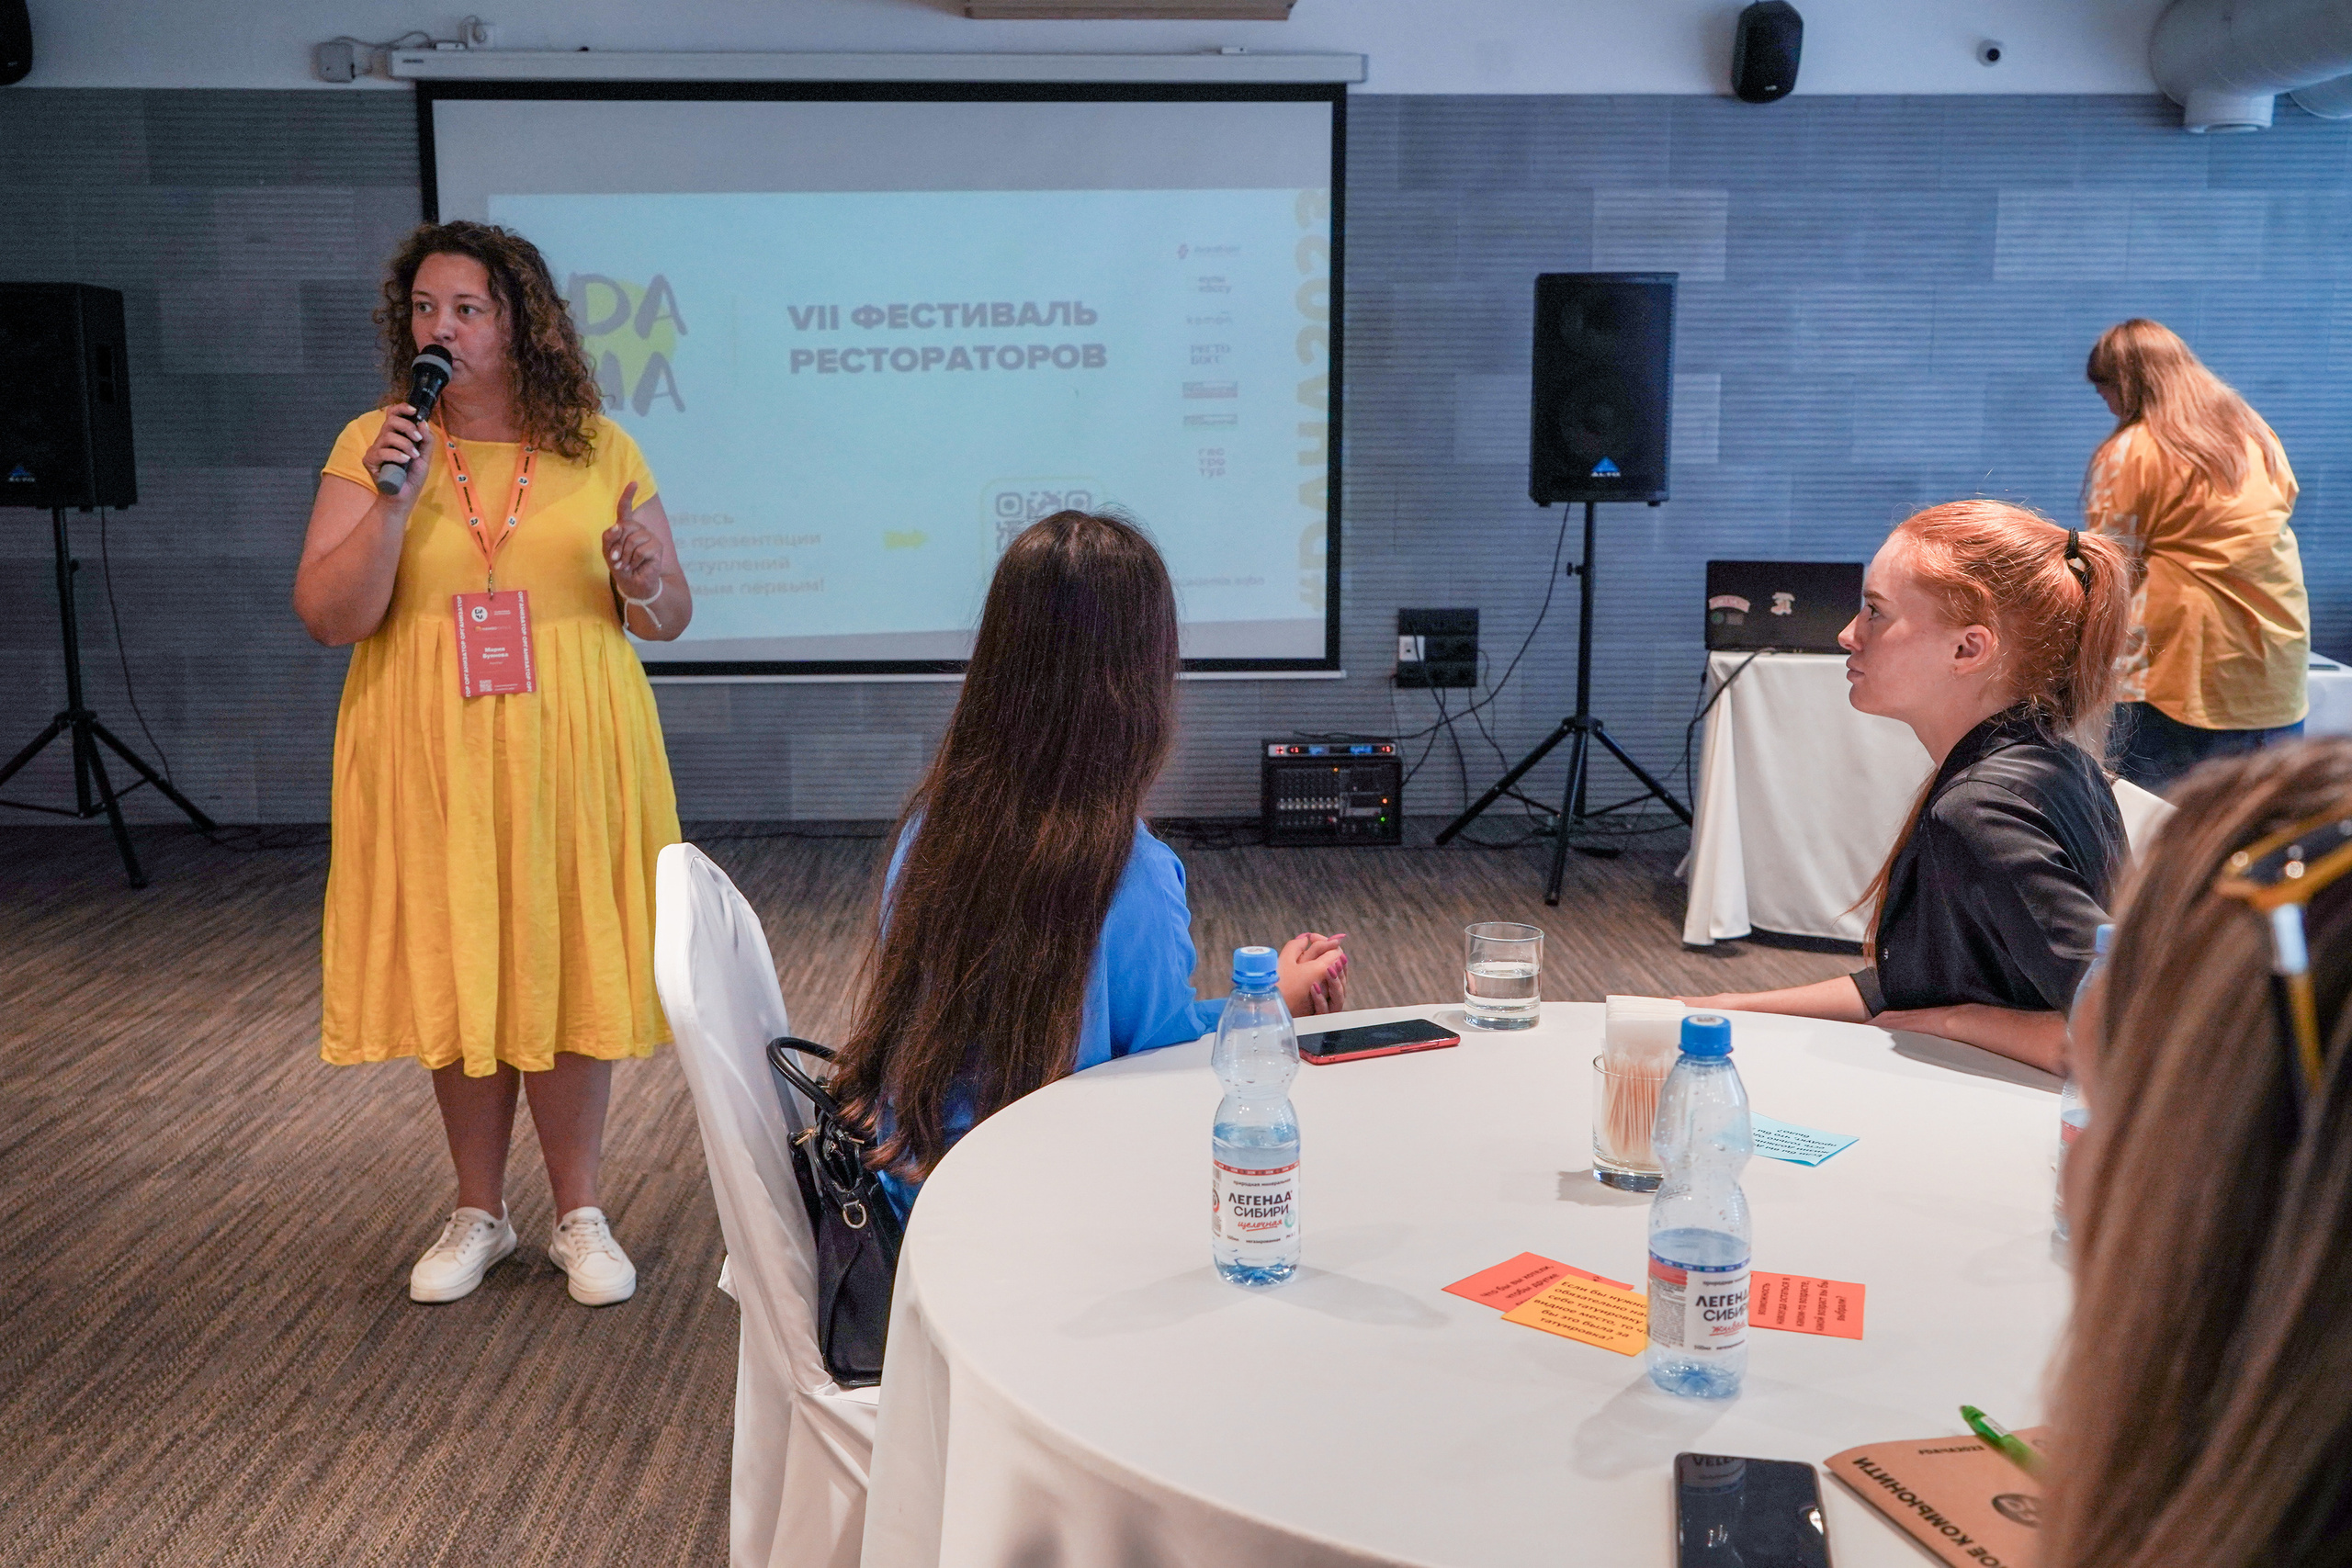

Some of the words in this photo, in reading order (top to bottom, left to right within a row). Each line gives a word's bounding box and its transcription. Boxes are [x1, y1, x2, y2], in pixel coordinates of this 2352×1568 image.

[787, 305, 839, 332] VII
[851, 300, 1099, 332] ФЕСТИВАЛЬ
[790, 344, 1107, 374] РЕСТОРАТОРОВ
[457, 595, 466, 640] ОРГАНИЗАТОР
[517, 592, 526, 636] ОРГАНИЗАТОР
[522, 637, 531, 681] ОРГАНИЗАТОР
[460, 640, 470, 685] ОРГАНИЗАТОР
[1228, 1190, 1292, 1205] ЛЕГЕНДА
[1234, 1203, 1289, 1218] СИБИРИ
[1238, 1219, 1283, 1229] щелочная
[1505, 1287, 1532, 1299] чтобы
[1532, 1273, 1560, 1289] другие
[1561, 1280, 1588, 1292] Если
[1590, 1290, 1607, 1298] бы
[1610, 1295, 1647, 1309] нужно
[1780, 1281, 1790, 1303] остаться
[1798, 1280, 1811, 1304] возрасте,
[1817, 1280, 1828, 1289] бы
[1548, 1294, 1575, 1304] себе
[1577, 1303, 1643, 1325] татуировку
[1555, 1289, 1627, 1312] обязательно
[1758, 1282, 1770, 1315] возможность
[1816, 1297, 1828, 1316] возраст
[1835, 1295, 1848, 1321] выбрали?
[1533, 1299, 1577, 1314] видное
[1578, 1312, 1616, 1325] место,
[1541, 1309, 1558, 1317] бы
[1560, 1314, 1580, 1323] это
[1582, 1320, 1614, 1334] была
[1776, 1303, 1788, 1325] навсегда
[1795, 1304, 1807, 1327] каком-то
[1814, 1316, 1825, 1332] какой
[1540, 1317, 1614, 1341] татуировка?
[1851, 1457, 1974, 1547] КОМЬЮНИТИ
[1966, 1546, 2007, 1568] ОЕ
